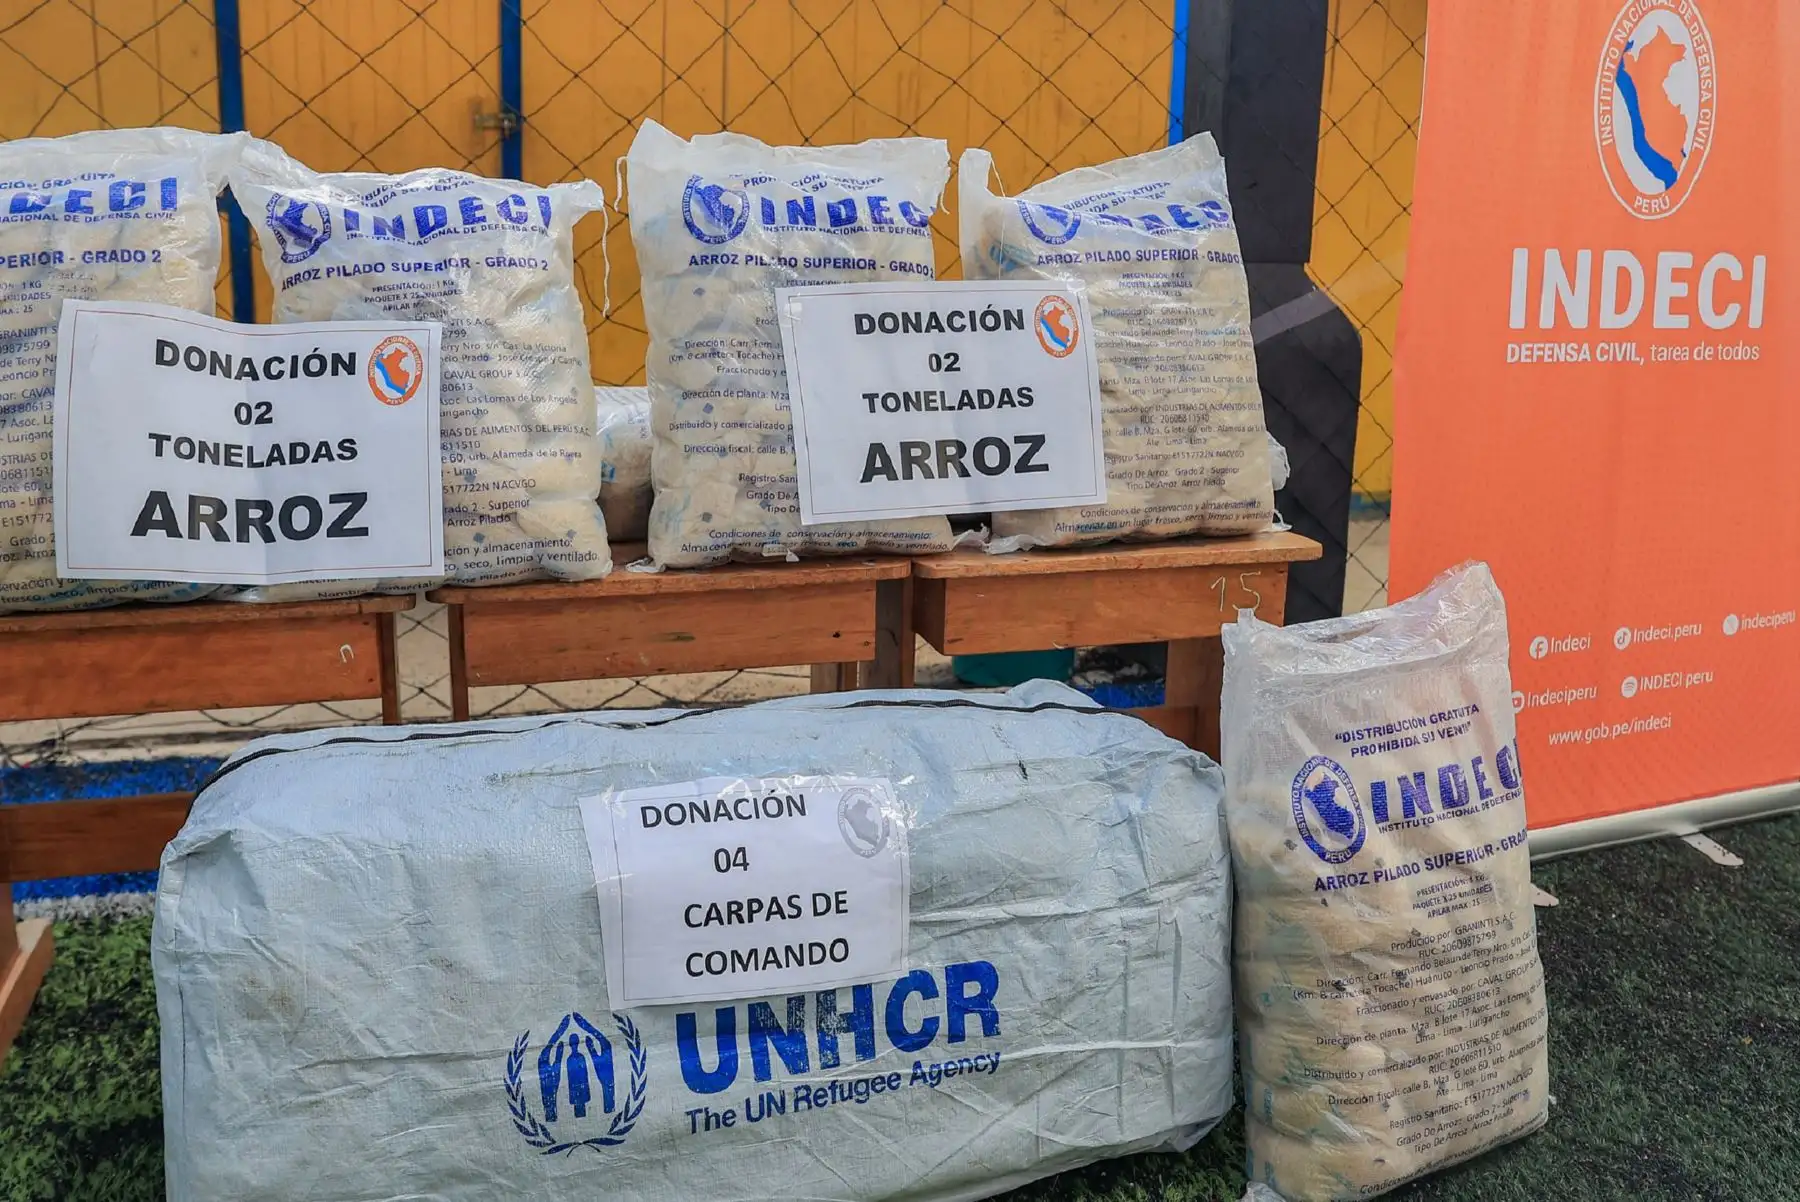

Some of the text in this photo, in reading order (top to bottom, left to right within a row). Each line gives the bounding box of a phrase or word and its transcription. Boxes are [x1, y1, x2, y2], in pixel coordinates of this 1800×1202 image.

[1679, 3, 1690, 22] DE
[1689, 24, 1713, 102] DEFENSA
[1600, 47, 1619, 146] INSTITUTO
[1693, 110, 1711, 150] CIVIL
[9, 177, 177, 214] DECI
[1634, 194, 1670, 213] PERÚ
[343, 194, 551, 239] INDECI
[761, 196, 935, 227] INDEC
[0, 249, 162, 268] PERIOR GRADO 2
[689, 254, 929, 276] ARROZ SUPERIOR GRADO
[1038, 249, 1240, 265] ARROZ PILADO SUPERIOR GRADO
[282, 269, 321, 292] ARROZ
[326, 262, 385, 279] PILADO
[392, 256, 470, 273] SUPERIOR
[1509, 248, 1766, 329] INDECI
[855, 304, 1025, 335] DONACIÓN
[155, 338, 357, 382] DONACIÓN
[736, 351, 775, 361] Tocache)
[929, 353, 961, 373] 02
[1506, 340, 1759, 365] DEFENSA CIVIL, tarea de todos
[444, 371, 476, 380] CAVAL
[717, 366, 770, 376] Fraccionado
[682, 390, 769, 400] Dirección planta:
[862, 387, 1034, 413] TONELADAS
[234, 401, 273, 425] 02
[481, 424, 532, 435] ALIMENTOS
[669, 421, 784, 431] Distribuido comercializado
[148, 433, 358, 469] TONELADAS
[450, 450, 533, 464] 60, Alameda
[757, 444, 777, 454] calle
[860, 434, 1049, 483] ARROZ
[454, 466, 478, 476] Lima
[738, 473, 776, 485] Registro
[489, 499, 530, 515] Superior
[746, 490, 775, 501] Grado
[130, 491, 369, 544] ARROZ
[448, 514, 511, 528] Arroz Pilado
[767, 505, 787, 515] Tipo
[1080, 508, 1129, 518] Condiciones
[10, 534, 45, 547] Grado
[482, 539, 573, 553] almacenamiento:
[709, 528, 931, 540] Condiciones conservación almacenamiento:
[463, 550, 599, 570] seco, limpio ventilado.
[1211, 571, 1261, 612] 15
[1741, 610, 1796, 631] indeciperu
[1551, 634, 1590, 654] Indeci
[1633, 623, 1702, 644] Indeci.peru
[1640, 670, 1714, 691] INDECI peru
[1528, 684, 1597, 708] Indeciperu
[1430, 704, 1479, 724] GRATUITA
[1549, 712, 1672, 745] www.gob.pe/indeci
[1351, 731, 1435, 758] PROHIBIDA SU
[640, 789, 808, 828] DONACIÓN
[1379, 806, 1480, 834] INSTITUTO NACIONAL
[714, 846, 750, 873] 04
[1315, 843, 1494, 892] ARROZ PILADO SUPERIOR
[684, 890, 849, 928] CARPAS DE
[1413, 883, 1493, 910] PAQUETE UNIDADES
[1427, 906, 1450, 919] APILAR
[1391, 919, 1493, 951] Producido GRANINTI
[1441, 930, 1496, 954] 20609875799
[685, 938, 849, 978] COMANDO
[1367, 970, 1388, 982] Carr.
[1434, 949, 1471, 968] Belaunde
[1472, 947, 1492, 960] Terry
[1493, 942, 1509, 952] Nro.
[1416, 970, 1452, 987] Huánuco
[1492, 953, 1514, 965] Prado
[1357, 999, 1409, 1016] Fraccionado
[1420, 985, 1458, 1003] envasado
[1478, 974, 1504, 990] CAVAL
[1380, 1026, 1409, 1041] planta:
[1441, 1011, 1458, 1023] lote
[1494, 997, 1506, 1009] Las
[1424, 1002, 1445, 1016] RUC:
[675, 960, 1001, 1095] UNHCR
[1415, 1009, 1510, 1044] Lima Lima Lurigancho
[1428, 1050, 1445, 1065] por:
[1446, 1033, 1490, 1056] INDUSTRIAS
[1502, 1016, 1538, 1039] ALIMENTOS
[1450, 1042, 1502, 1070] 20606811510
[685, 1051, 1001, 1137] The UN Refugee Agency
[1402, 1081, 1422, 1094] calle
[1436, 1070, 1498, 1098] Ate Lima Lima
[1389, 1113, 1422, 1130] Registro
[1424, 1101, 1462, 1120] Sanitario:
[1396, 1132, 1422, 1147] Grado
[1466, 1108, 1490, 1122] Grado
[1414, 1140, 1431, 1154] Tipo
